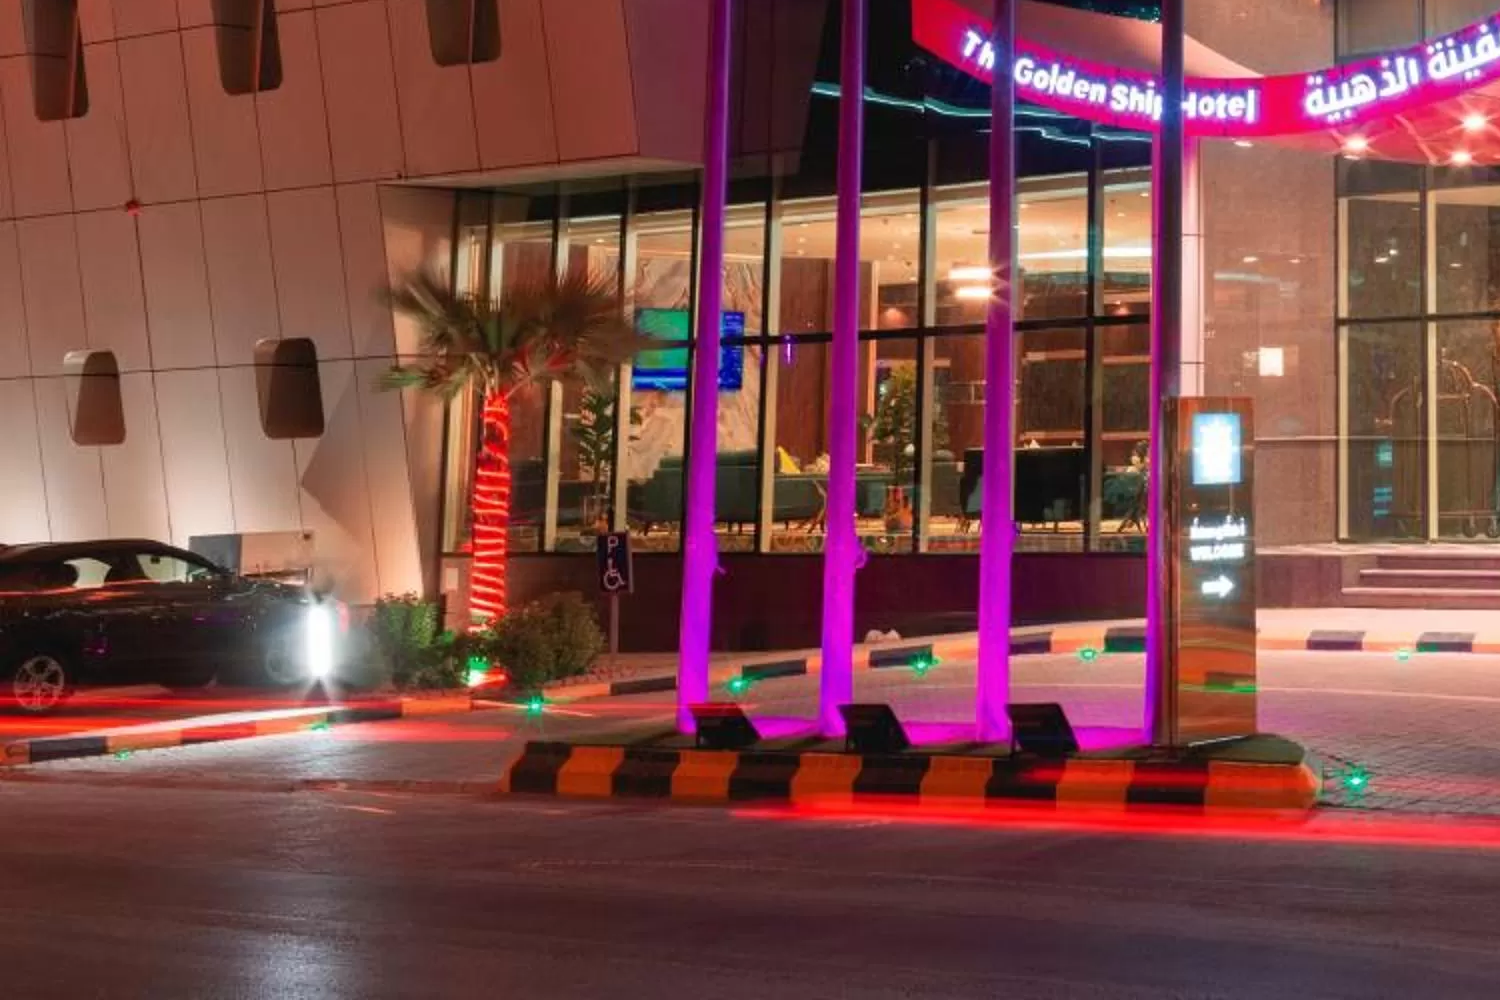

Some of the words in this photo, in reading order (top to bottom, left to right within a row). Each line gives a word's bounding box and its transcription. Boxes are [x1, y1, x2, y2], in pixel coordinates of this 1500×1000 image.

[962, 29, 997, 71] Th
[1014, 56, 1107, 104] Golden
[1303, 57, 1421, 123] الذهبية
[607, 535, 620, 554] P
